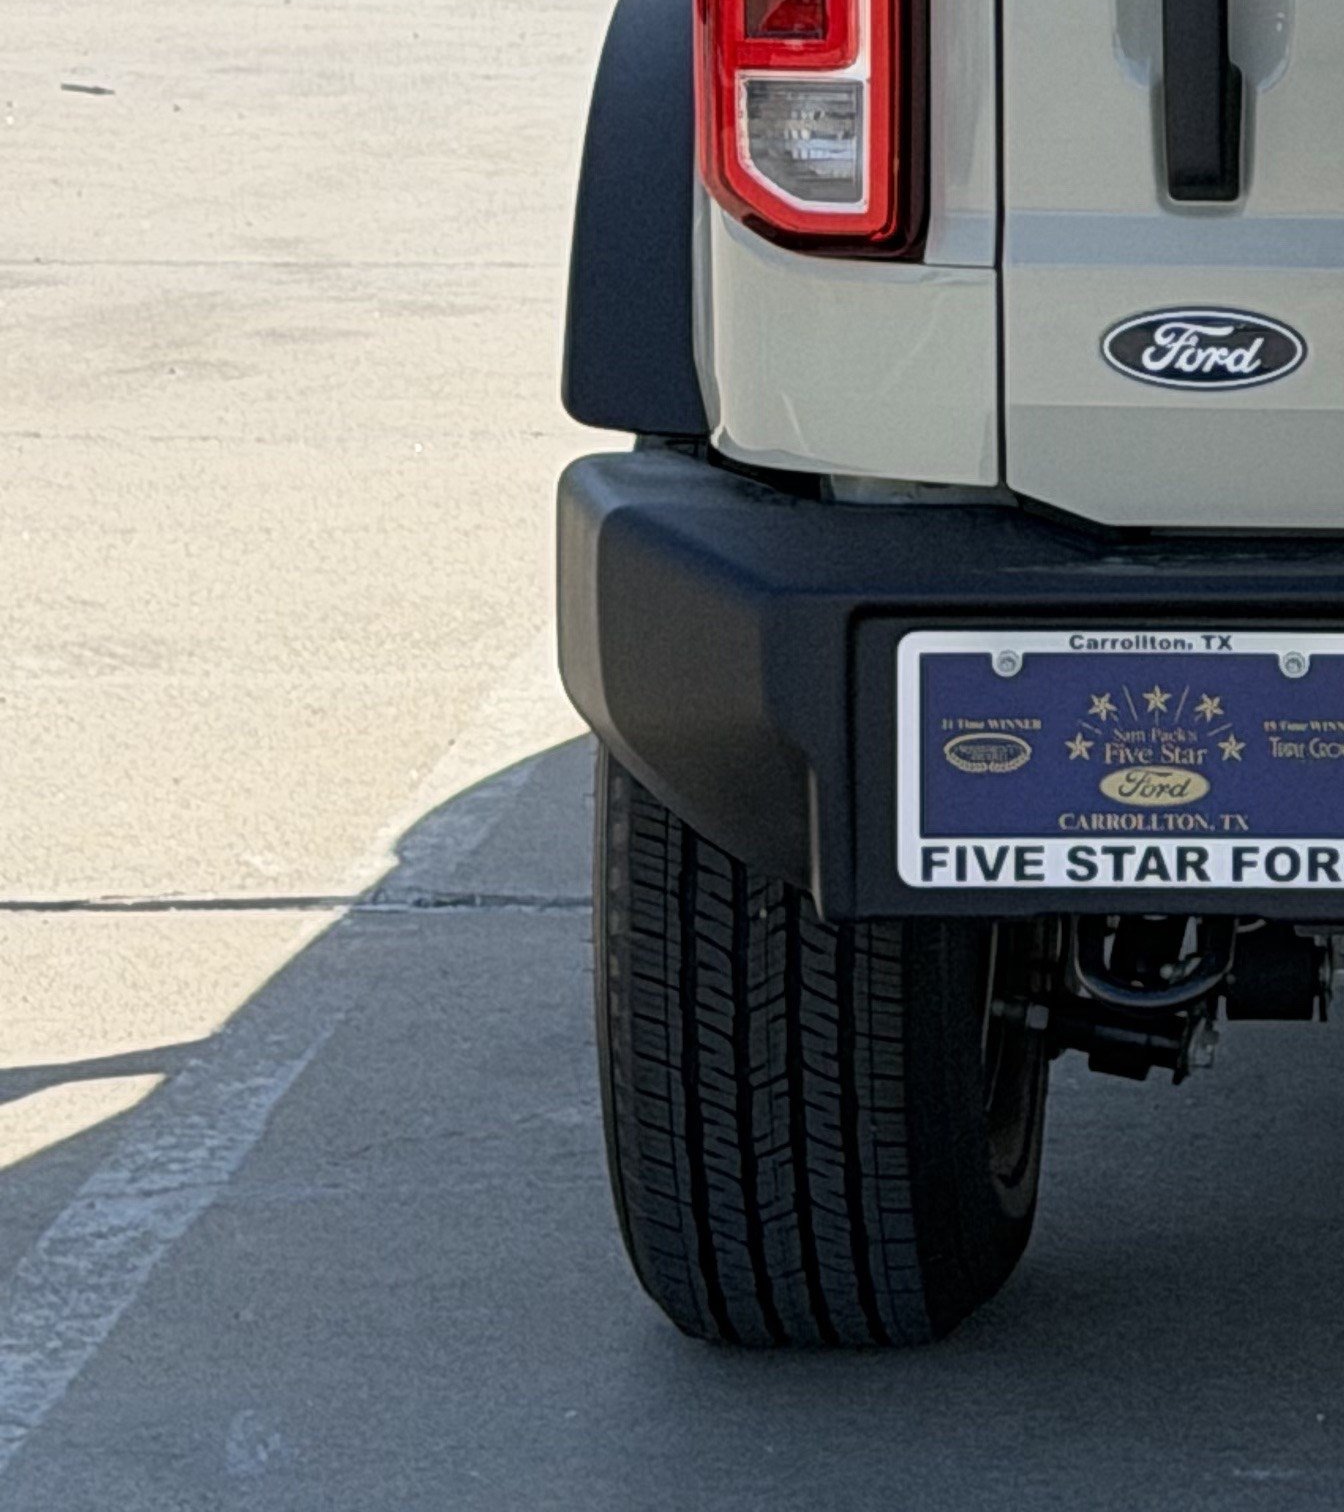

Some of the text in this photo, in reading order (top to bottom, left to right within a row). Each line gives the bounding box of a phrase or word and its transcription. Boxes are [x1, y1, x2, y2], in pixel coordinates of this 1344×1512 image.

[1141, 321, 1265, 374] Ford
[1068, 633, 1234, 653] Carrollton, TX
[1104, 742, 1208, 765] Five Star
[1118, 770, 1191, 798] Ford
[1220, 813, 1249, 831] TX
[920, 845, 1046, 883] FIVE
[1066, 845, 1211, 883] STAR
